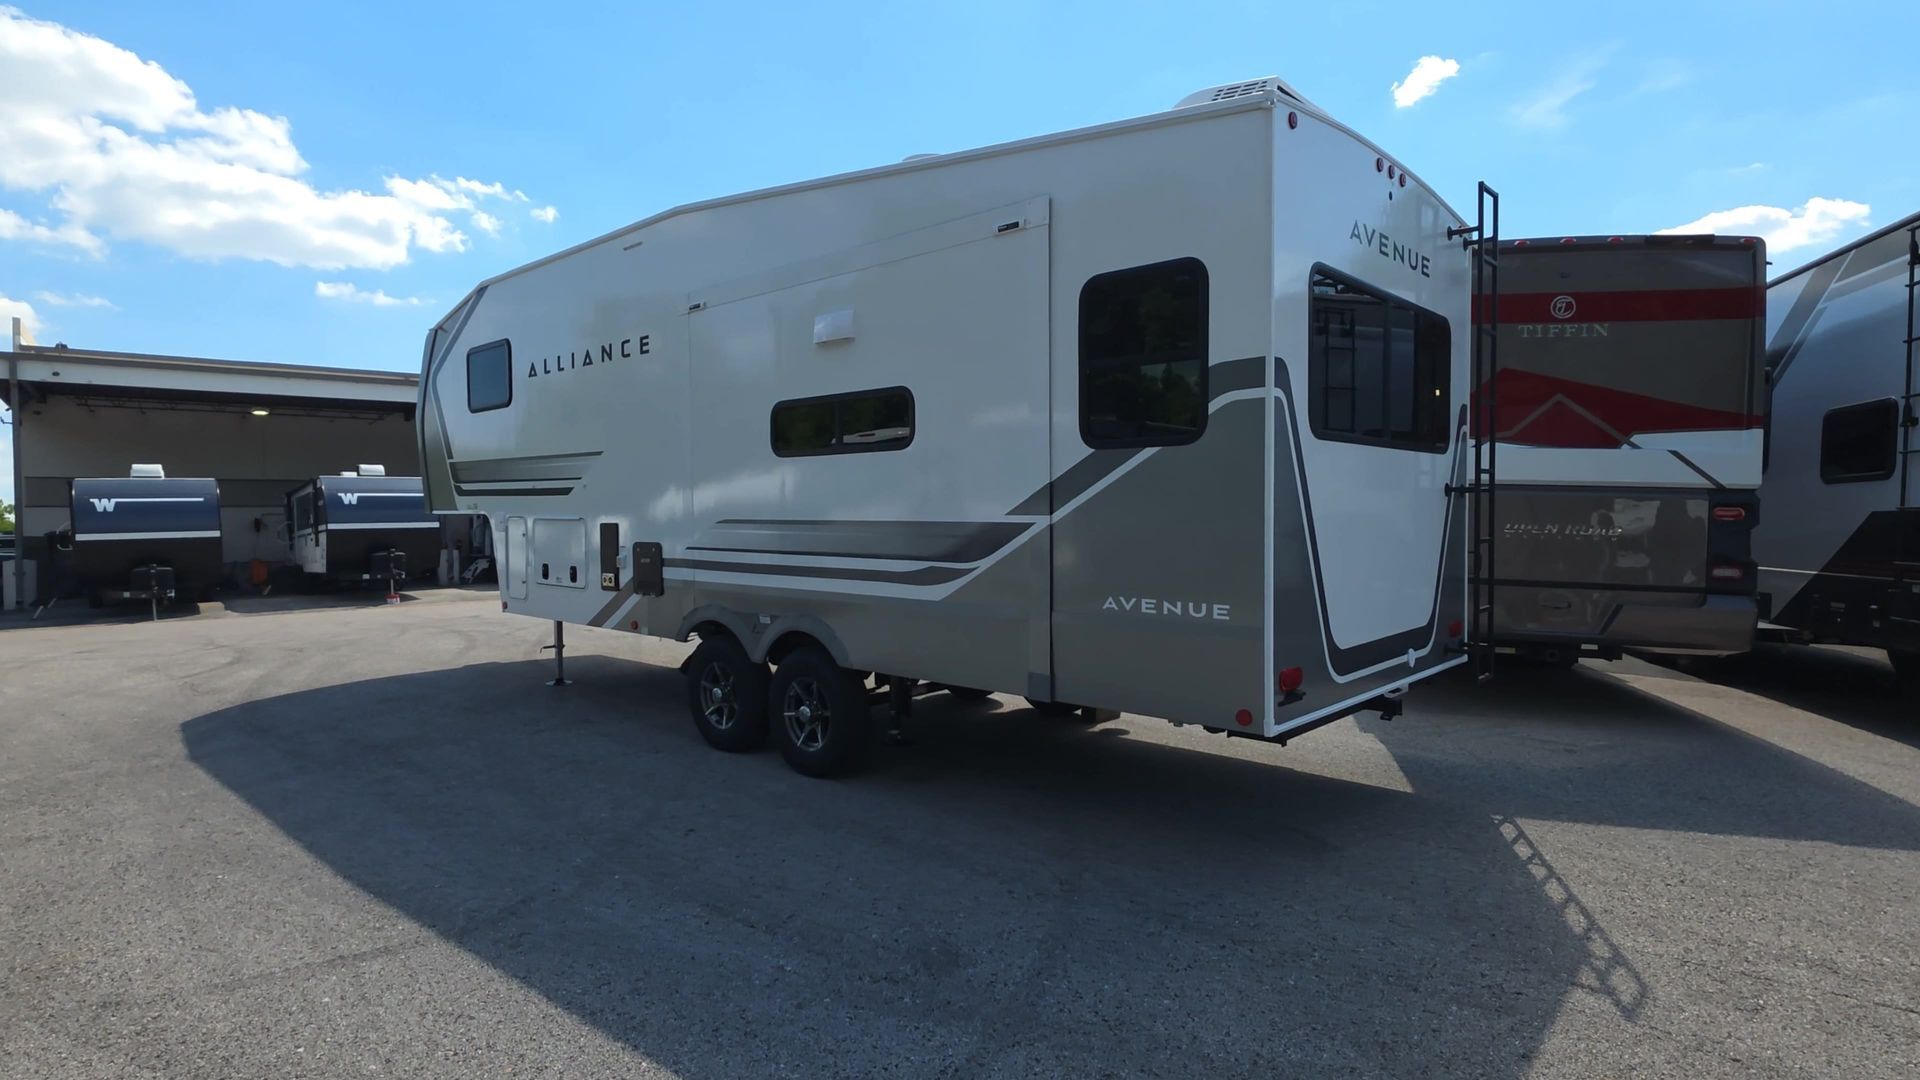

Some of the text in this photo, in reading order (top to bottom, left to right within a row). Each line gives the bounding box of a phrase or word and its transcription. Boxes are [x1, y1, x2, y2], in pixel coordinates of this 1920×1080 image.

[1349, 219, 1431, 279] AVENUE
[1518, 323, 1609, 338] TIFFIN
[528, 334, 650, 378] ALLIANCE
[1102, 596, 1231, 620] AVENUE
